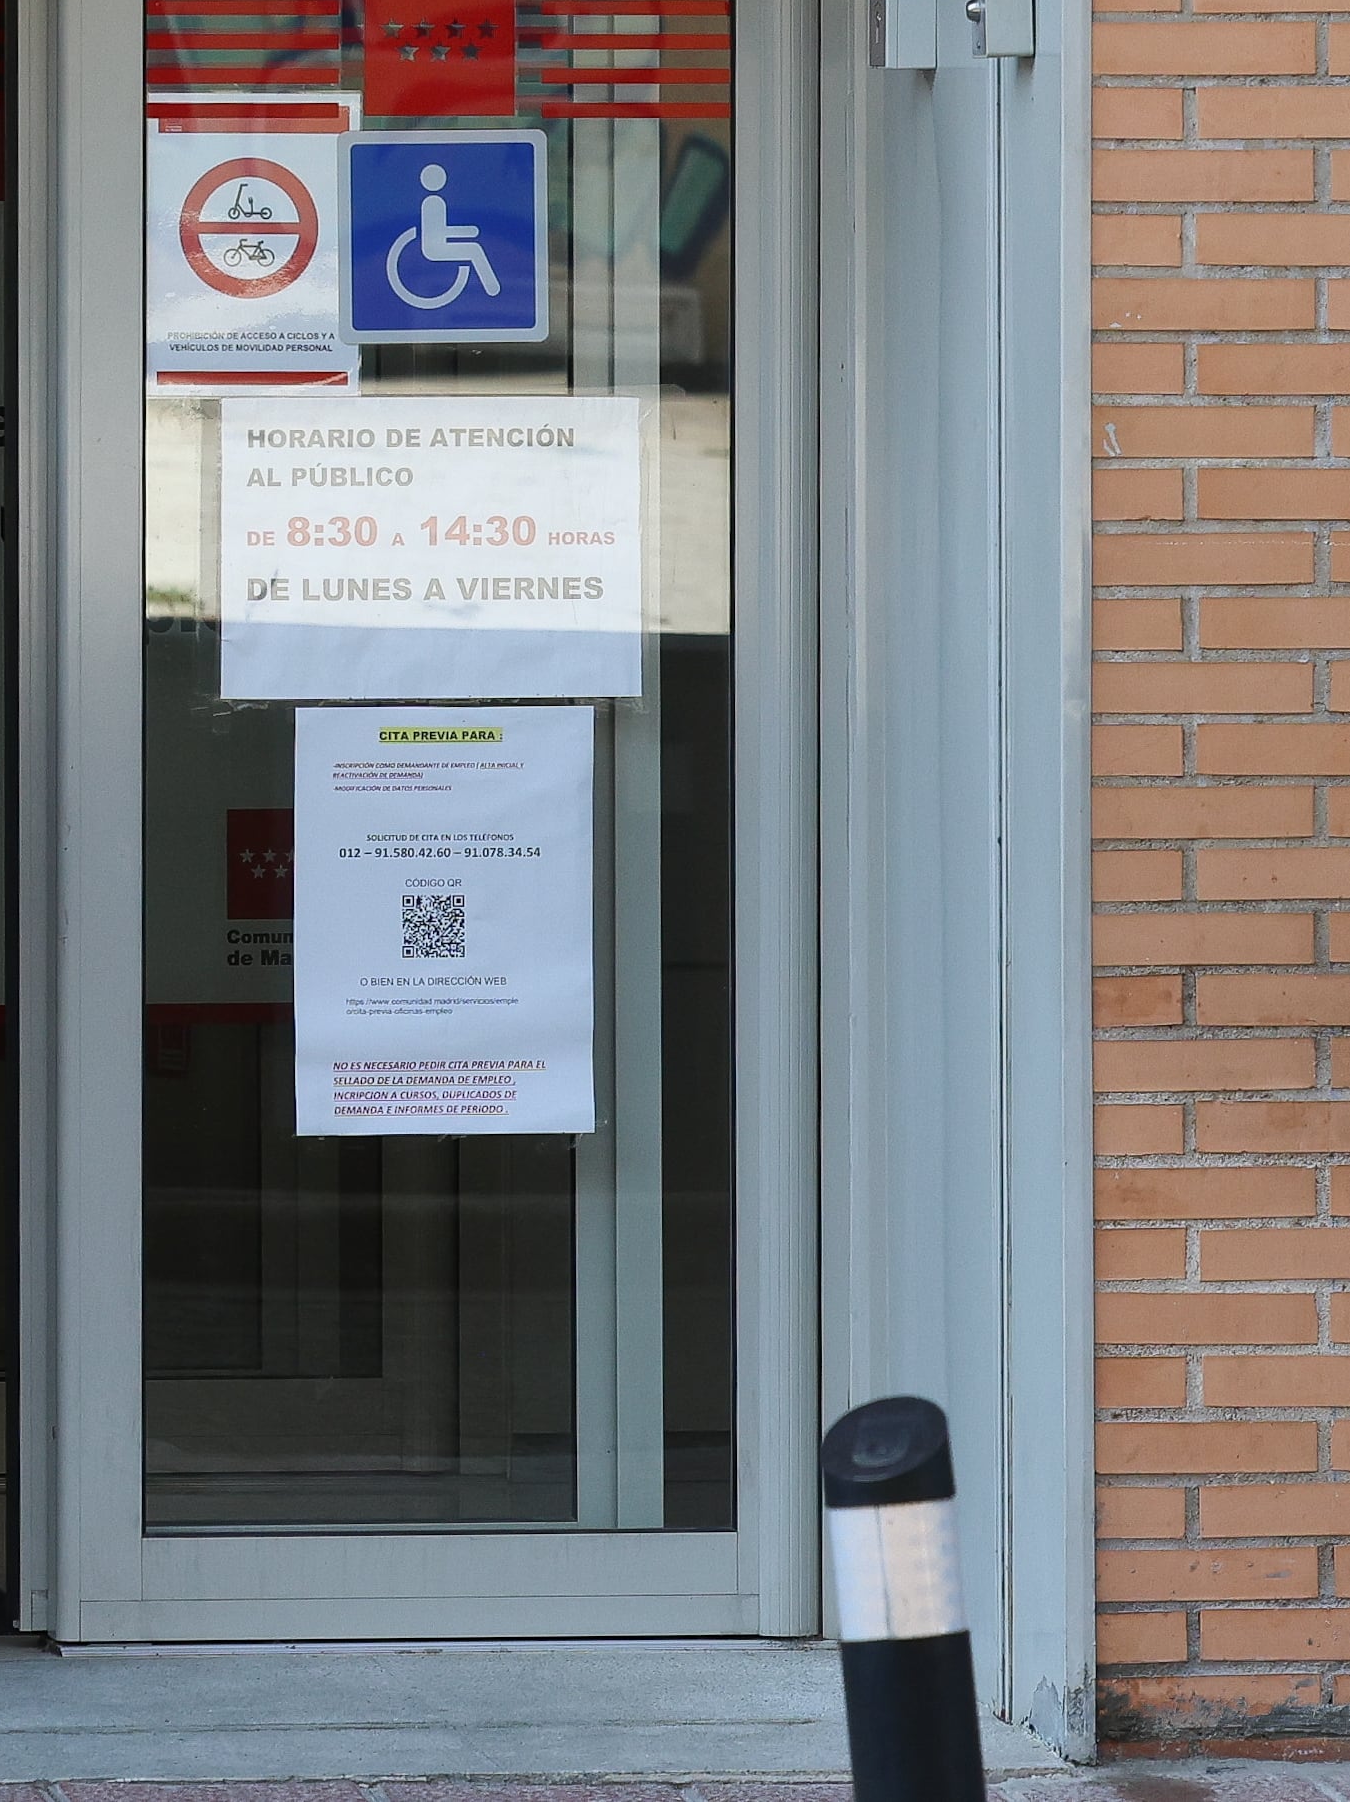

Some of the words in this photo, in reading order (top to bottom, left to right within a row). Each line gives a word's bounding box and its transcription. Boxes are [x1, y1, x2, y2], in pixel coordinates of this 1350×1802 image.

[167, 330, 224, 340] PROHIBICIÓN
[226, 331, 239, 340] DE
[240, 331, 277, 340] ACCESO
[278, 331, 286, 341] A
[286, 331, 319, 341] CICLOS
[320, 331, 327, 341] Y
[328, 331, 335, 341] A
[169, 341, 219, 352] VEHÍCULOS
[221, 343, 233, 352] DE
[235, 343, 282, 353] MOVILIDAD
[285, 343, 333, 353] PERSONAL
[247, 428, 375, 448] HORARIO
[386, 428, 420, 448] DE
[430, 423, 574, 448] ATENCIÓN
[247, 467, 281, 487] AL
[291, 463, 414, 487] PÚBLICO
[247, 531, 275, 546] DE
[287, 516, 377, 547] 8:30
[392, 533, 405, 546] A
[420, 516, 536, 547] 14:30
[548, 531, 615, 546] HORAS
[247, 578, 290, 601] DE
[302, 577, 412, 601] LUNES
[423, 578, 446, 600] A
[456, 576, 604, 601] VIERNES
[379, 731, 409, 741] CITA
[413, 731, 459, 741] PREVIA
[462, 731, 496, 741] PARA
[339, 848, 361, 858] 012
[375, 848, 451, 858] 91.580.42.60
[464, 847, 540, 858] 91.078.34.54
[405, 877, 444, 888] CÓDIGO
[447, 878, 462, 888] QR
[227, 950, 253, 965] de
[360, 978, 368, 986] O
[371, 978, 393, 986] BIEN
[396, 978, 410, 986] EN
[413, 978, 425, 986] LA
[428, 976, 481, 986] DIRECCIÓN
[485, 977, 507, 985] WEB
[333, 1062, 348, 1070] NO
[350, 1062, 362, 1070] ES
[364, 1062, 416, 1070] NECESARIO
[419, 1061, 446, 1070] PEDIR
[448, 1061, 469, 1069] CITA
[471, 1061, 505, 1069] PREVIA
[508, 1061, 533, 1069] PARA
[536, 1061, 546, 1069] EL
[333, 1077, 375, 1085] SELLADO
[377, 1077, 390, 1085] DE
[406, 1076, 455, 1084] DEMANDA
[457, 1076, 470, 1084] DE
[472, 1076, 512, 1084] EMPLEO
[334, 1091, 388, 1100] INCRIPCION
[390, 1091, 397, 1099] A
[442, 1090, 501, 1099] DUPLICADOS
[504, 1090, 517, 1099] DE
[335, 1106, 383, 1115] DEMANDA
[386, 1106, 392, 1114] E
[394, 1106, 444, 1114] INFORMES
[446, 1105, 459, 1114] DE
